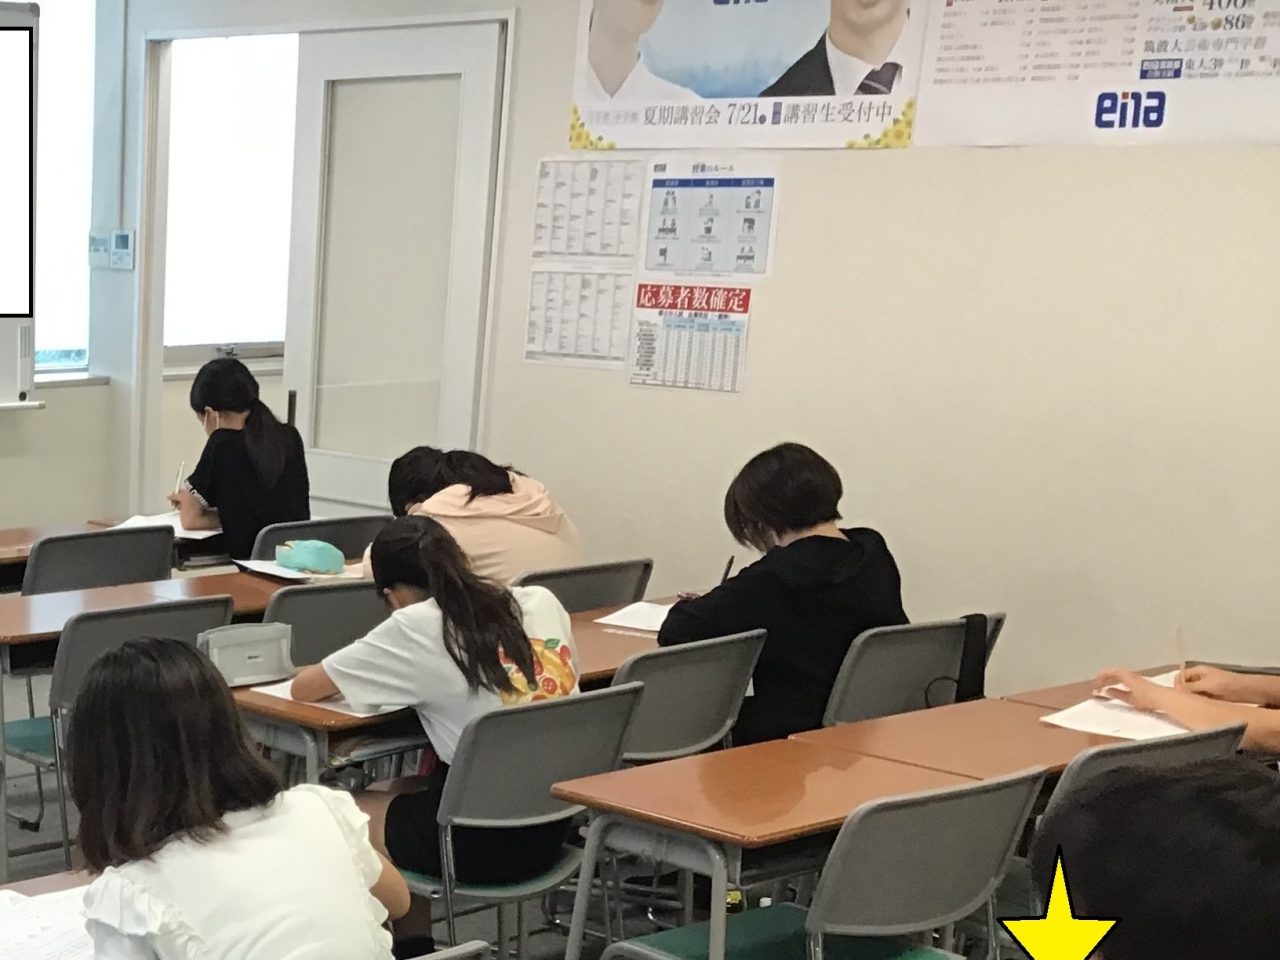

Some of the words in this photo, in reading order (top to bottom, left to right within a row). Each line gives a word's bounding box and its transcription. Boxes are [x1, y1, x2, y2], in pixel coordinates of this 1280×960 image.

[643, 104, 721, 126] 夏期講習会
[783, 101, 893, 124] 講習生受付中
[640, 285, 747, 312] 応募者数確定
